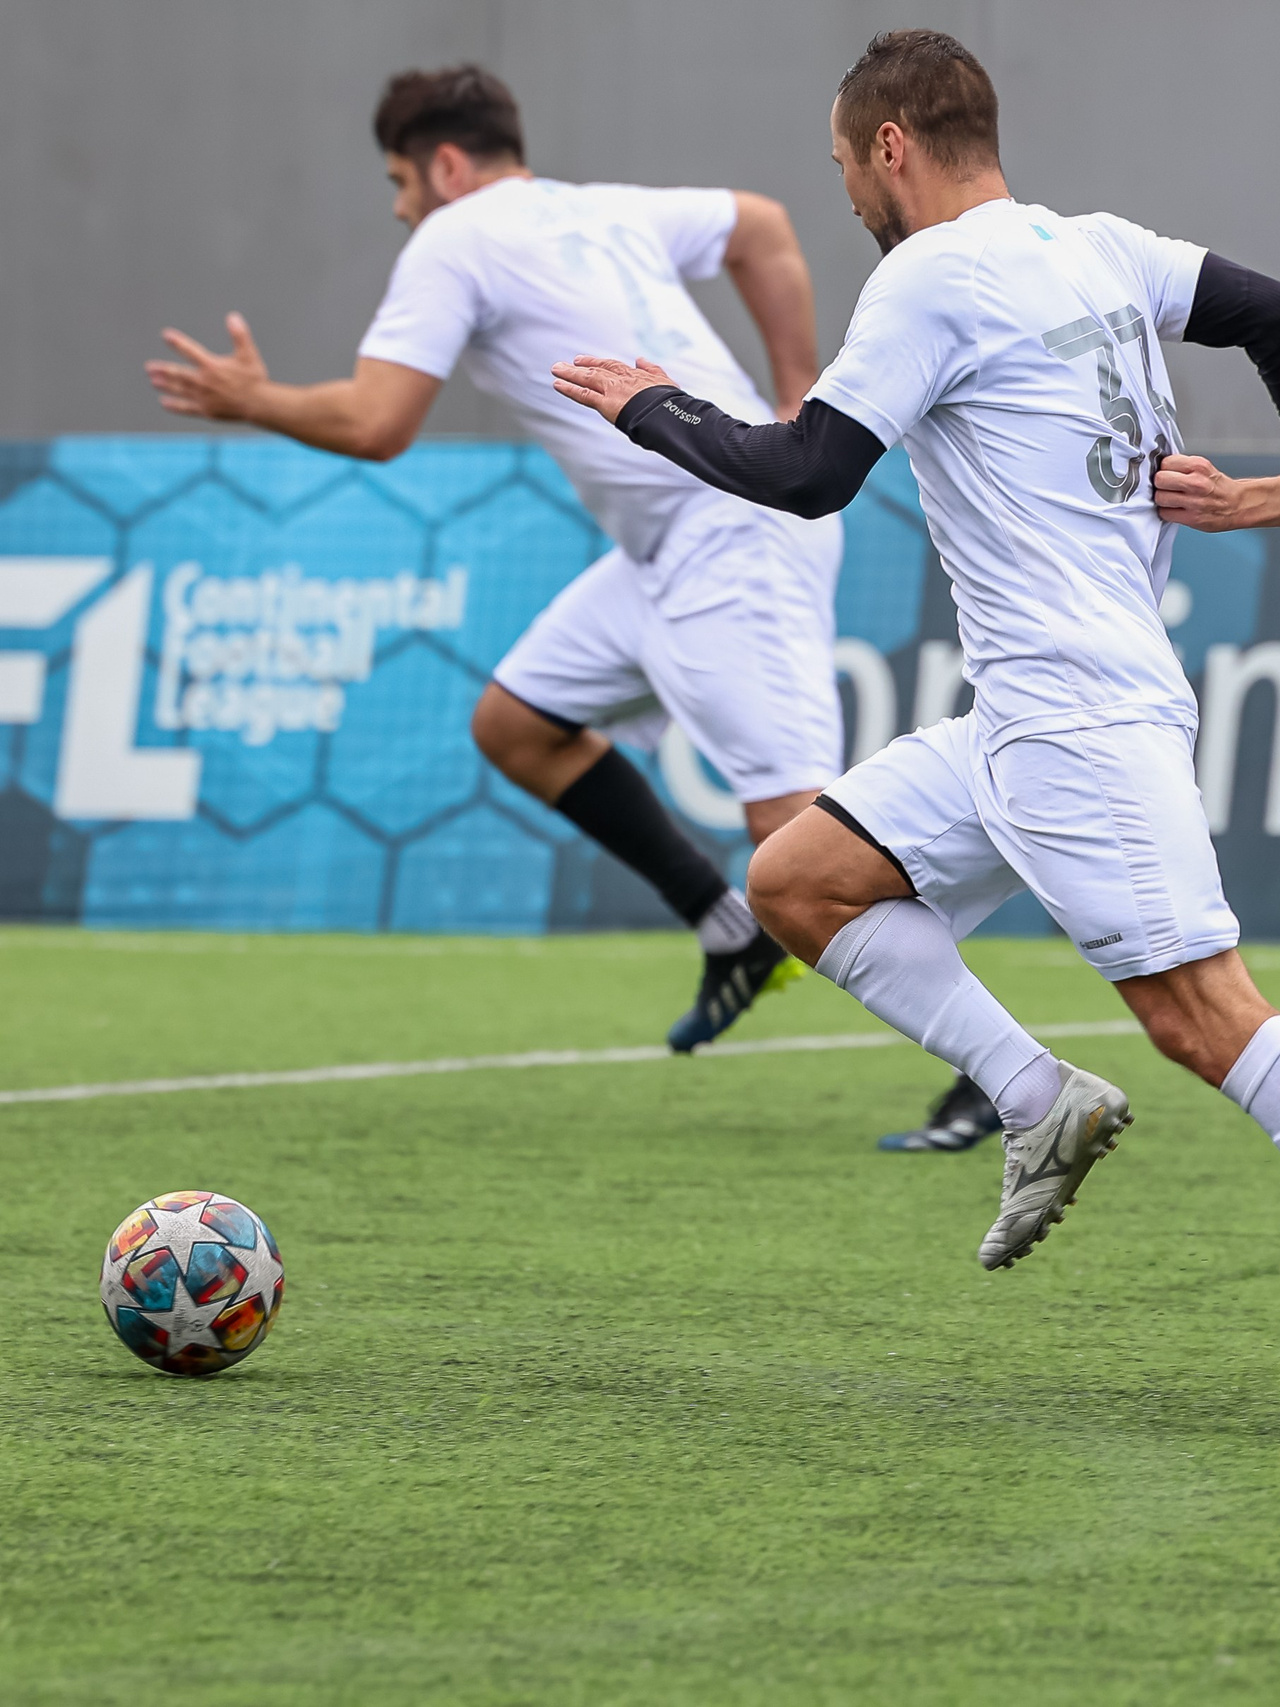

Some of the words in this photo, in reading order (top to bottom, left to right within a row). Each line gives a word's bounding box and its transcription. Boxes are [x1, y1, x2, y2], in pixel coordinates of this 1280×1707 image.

[163, 562, 468, 630] Continental
[160, 617, 376, 682] Football
[155, 675, 345, 746] League
